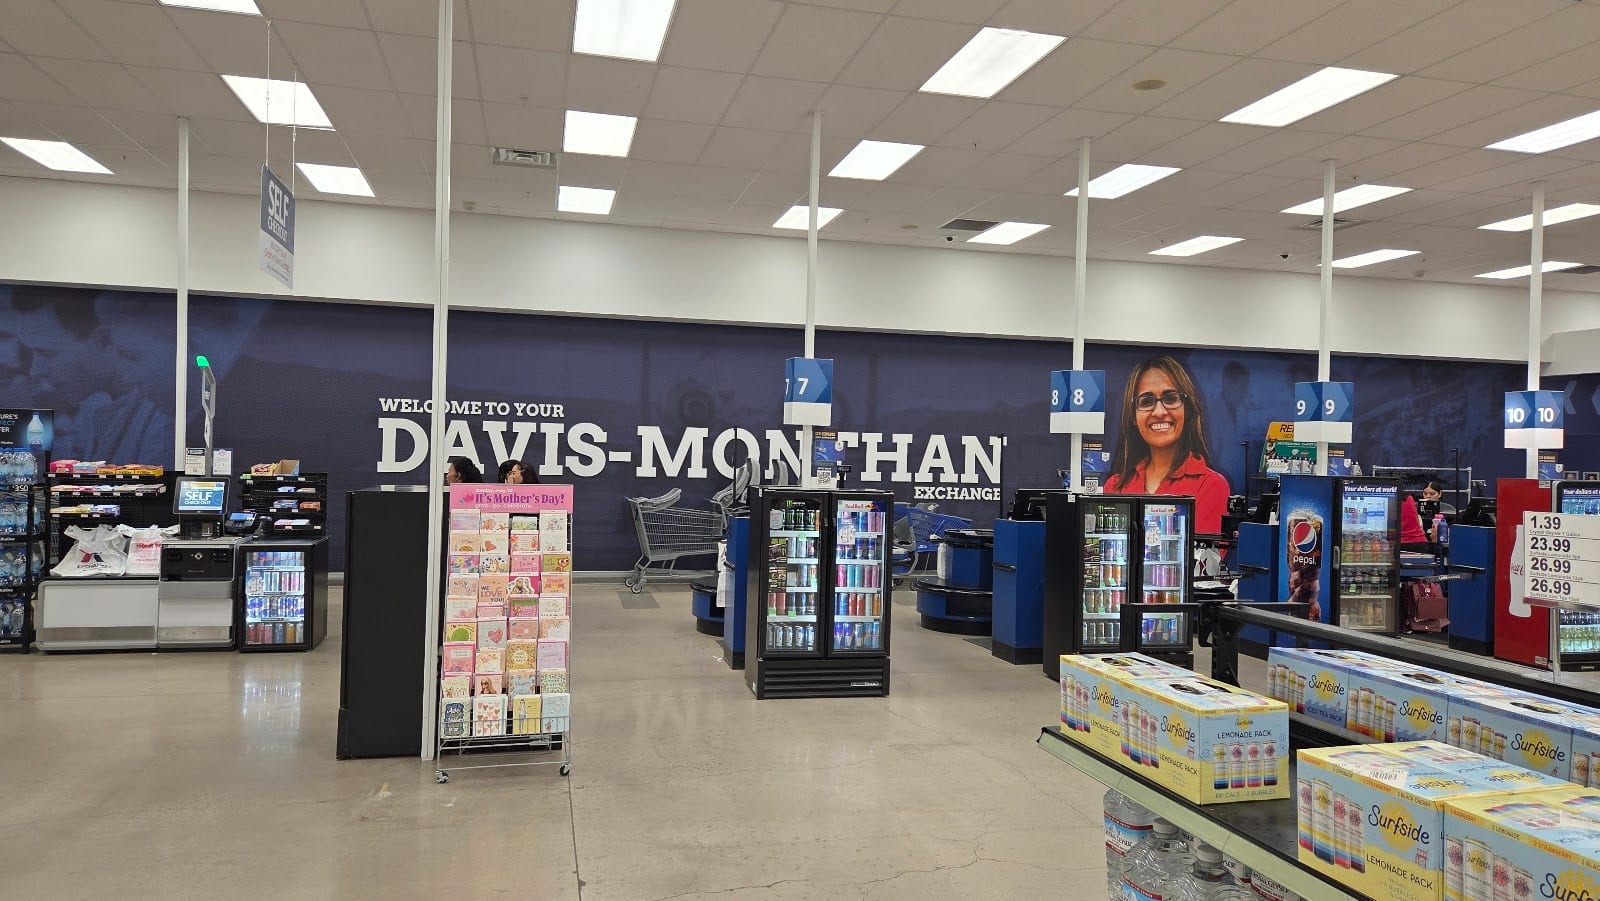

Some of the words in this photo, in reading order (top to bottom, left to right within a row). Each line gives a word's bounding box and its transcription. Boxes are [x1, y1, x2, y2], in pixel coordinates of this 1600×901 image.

[268, 180, 289, 227] SELF
[797, 377, 809, 395] 7
[1051, 389, 1059, 406] 8
[1073, 389, 1084, 405] 8
[485, 401, 510, 416] TO
[514, 403, 565, 418] YOUR
[1296, 400, 1306, 416] 9
[1325, 399, 1335, 415] 9
[1507, 407, 1525, 423] 10
[1537, 407, 1554, 423] 10
[1280, 424, 1294, 433] RE
[185, 492, 213, 500] SELF
[476, 493, 492, 504] It's
[493, 493, 540, 504] Mother's
[541, 494, 564, 505] Day!
[914, 486, 1001, 500] EXCHANGE
[1531, 516, 1561, 529] 1.39
[1531, 537, 1571, 552] 23.99
[1293, 555, 1315, 565] pepsi
[1531, 557, 1571, 573] 26.99
[481, 587, 503, 598] LOVE
[1531, 578, 1571, 595] 26.99
[1308, 675, 1345, 695] Surfside
[1092, 686, 1119, 708] Surfside
[1400, 701, 1443, 724] Surfside
[1090, 720, 1109, 733] LEMONADE
[1110, 728, 1120, 737] PACK
[1161, 715, 1196, 742] Surfside
[1217, 730, 1253, 739] LEMONADE
[1511, 733, 1565, 761] Surfside
[1160, 753, 1184, 770] LEMONADE
[1184, 765, 1199, 776] PACK
[1368, 805, 1430, 844] Surfside
[1496, 826, 1520, 839] LEMONADE
[1538, 842, 1572, 859] STRAWBERRY
[1367, 853, 1408, 879] LEMONADE
[1410, 873, 1433, 890] PACK
